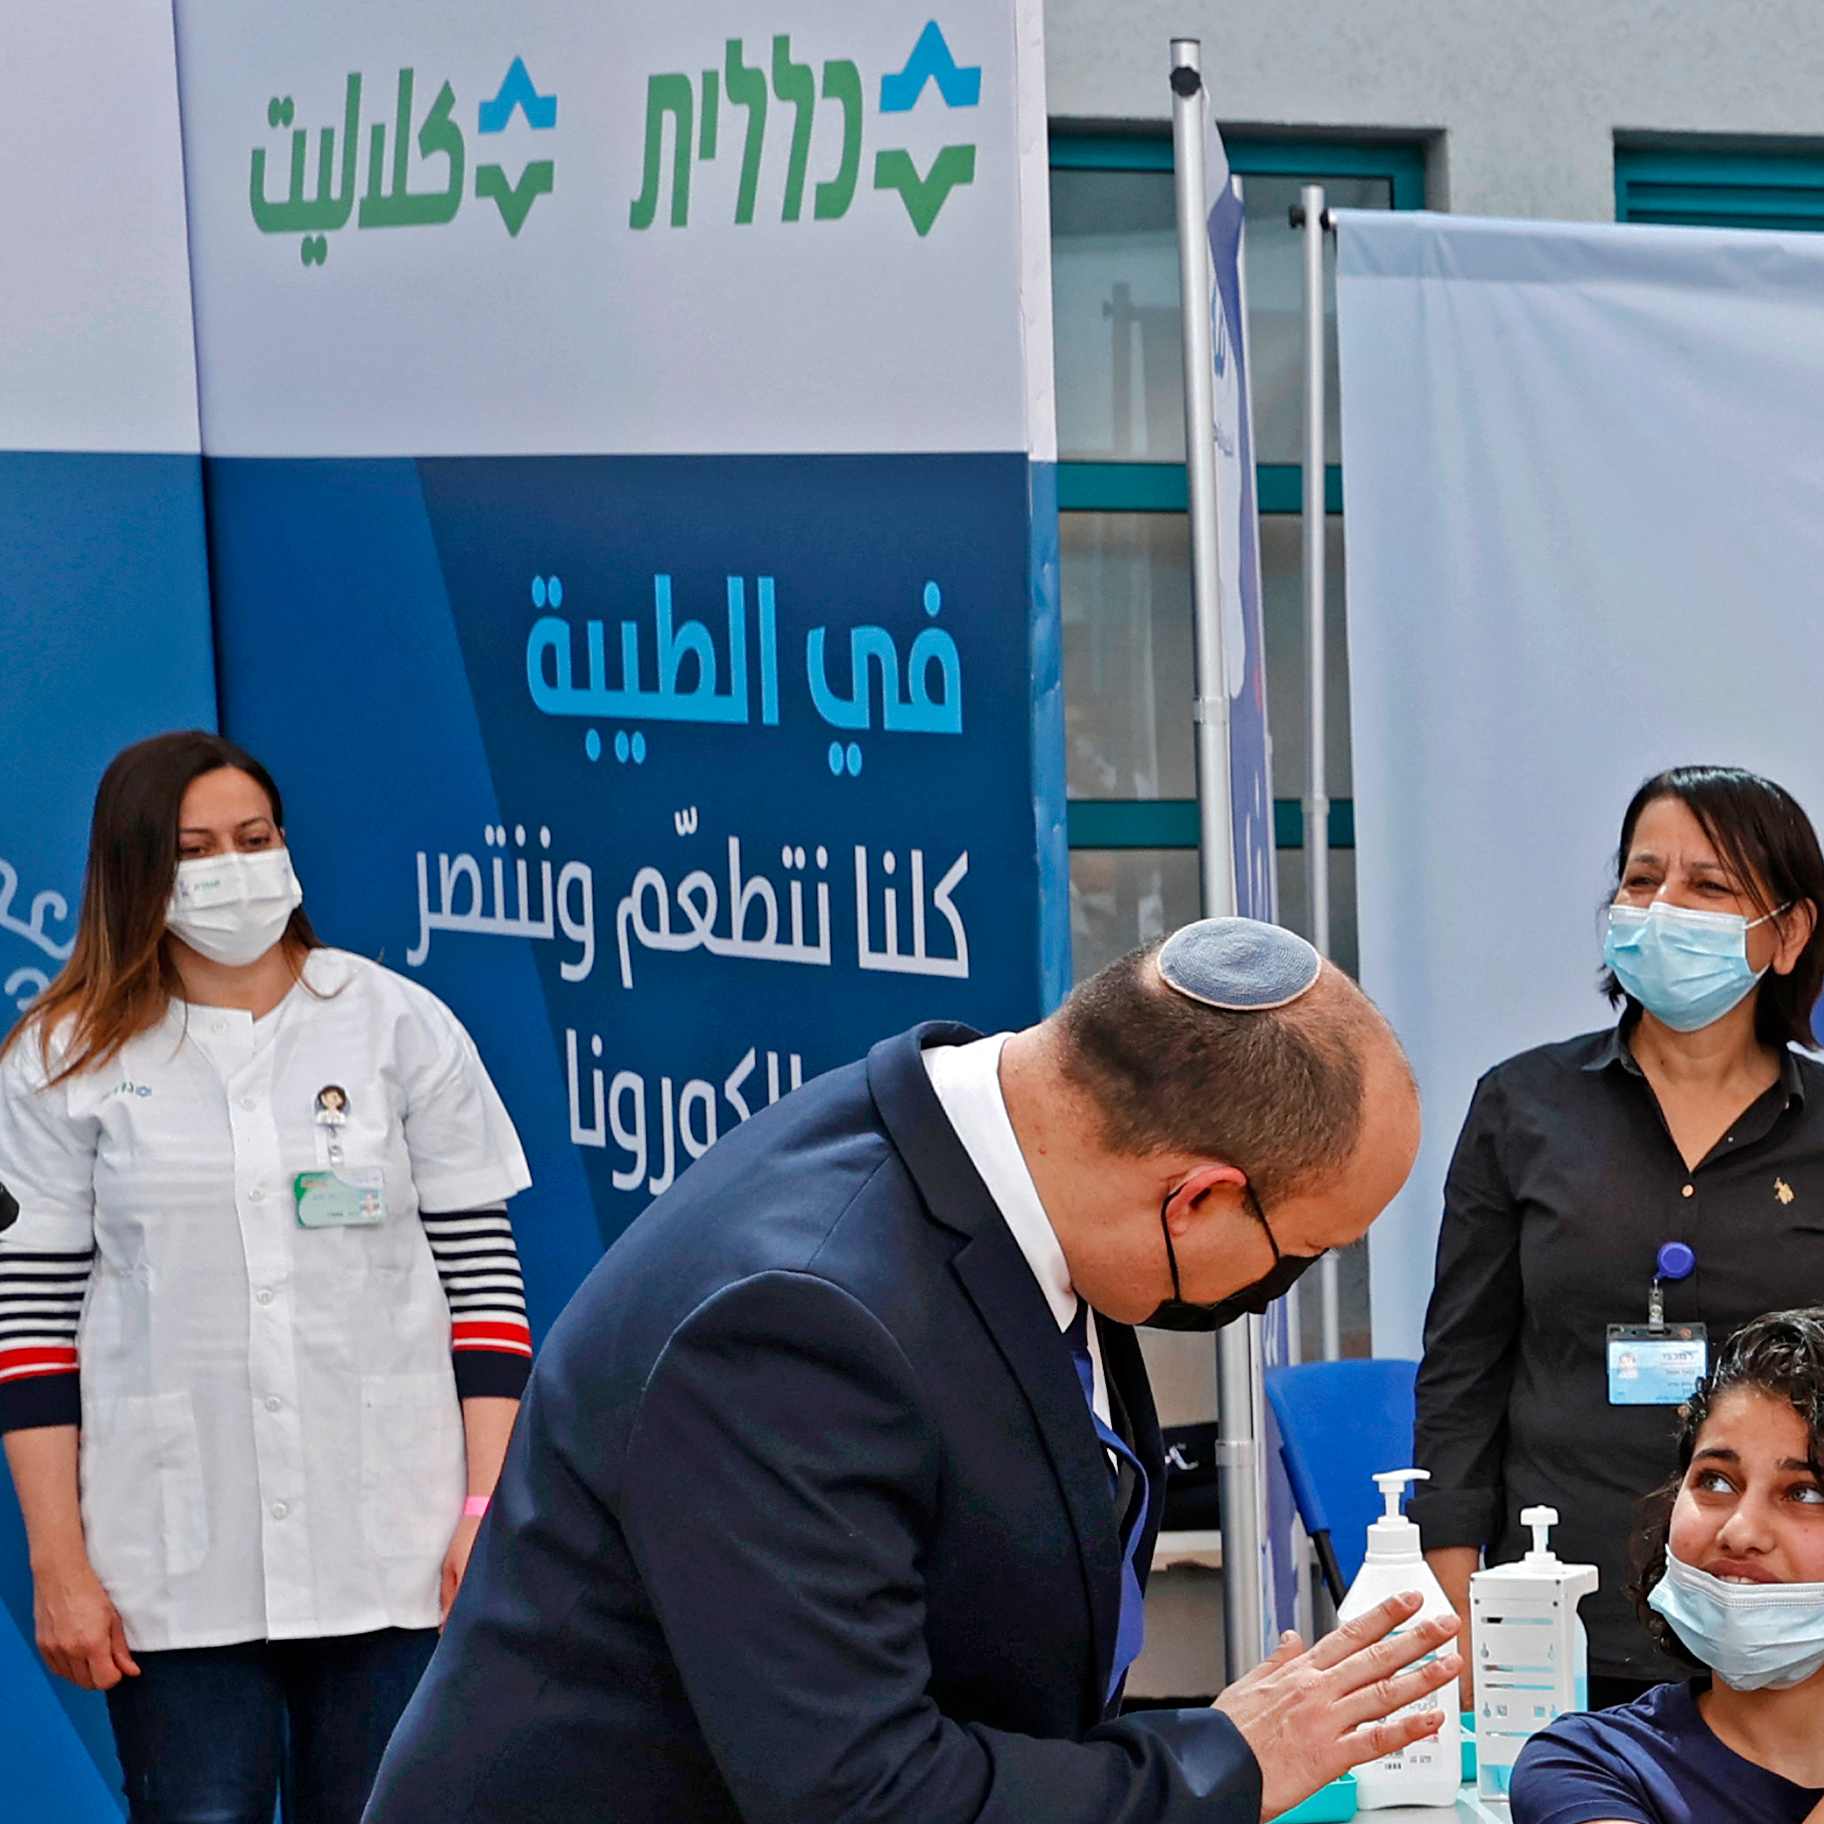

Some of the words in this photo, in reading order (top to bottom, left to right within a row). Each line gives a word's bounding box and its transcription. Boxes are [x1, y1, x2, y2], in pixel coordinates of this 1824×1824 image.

[630, 34, 863, 231] כללית
[527, 574, 779, 764] الطيبة
[806, 581, 962, 776] في
[406, 824, 595, 983] وننتصر
[854, 845, 970, 979] كلنا
